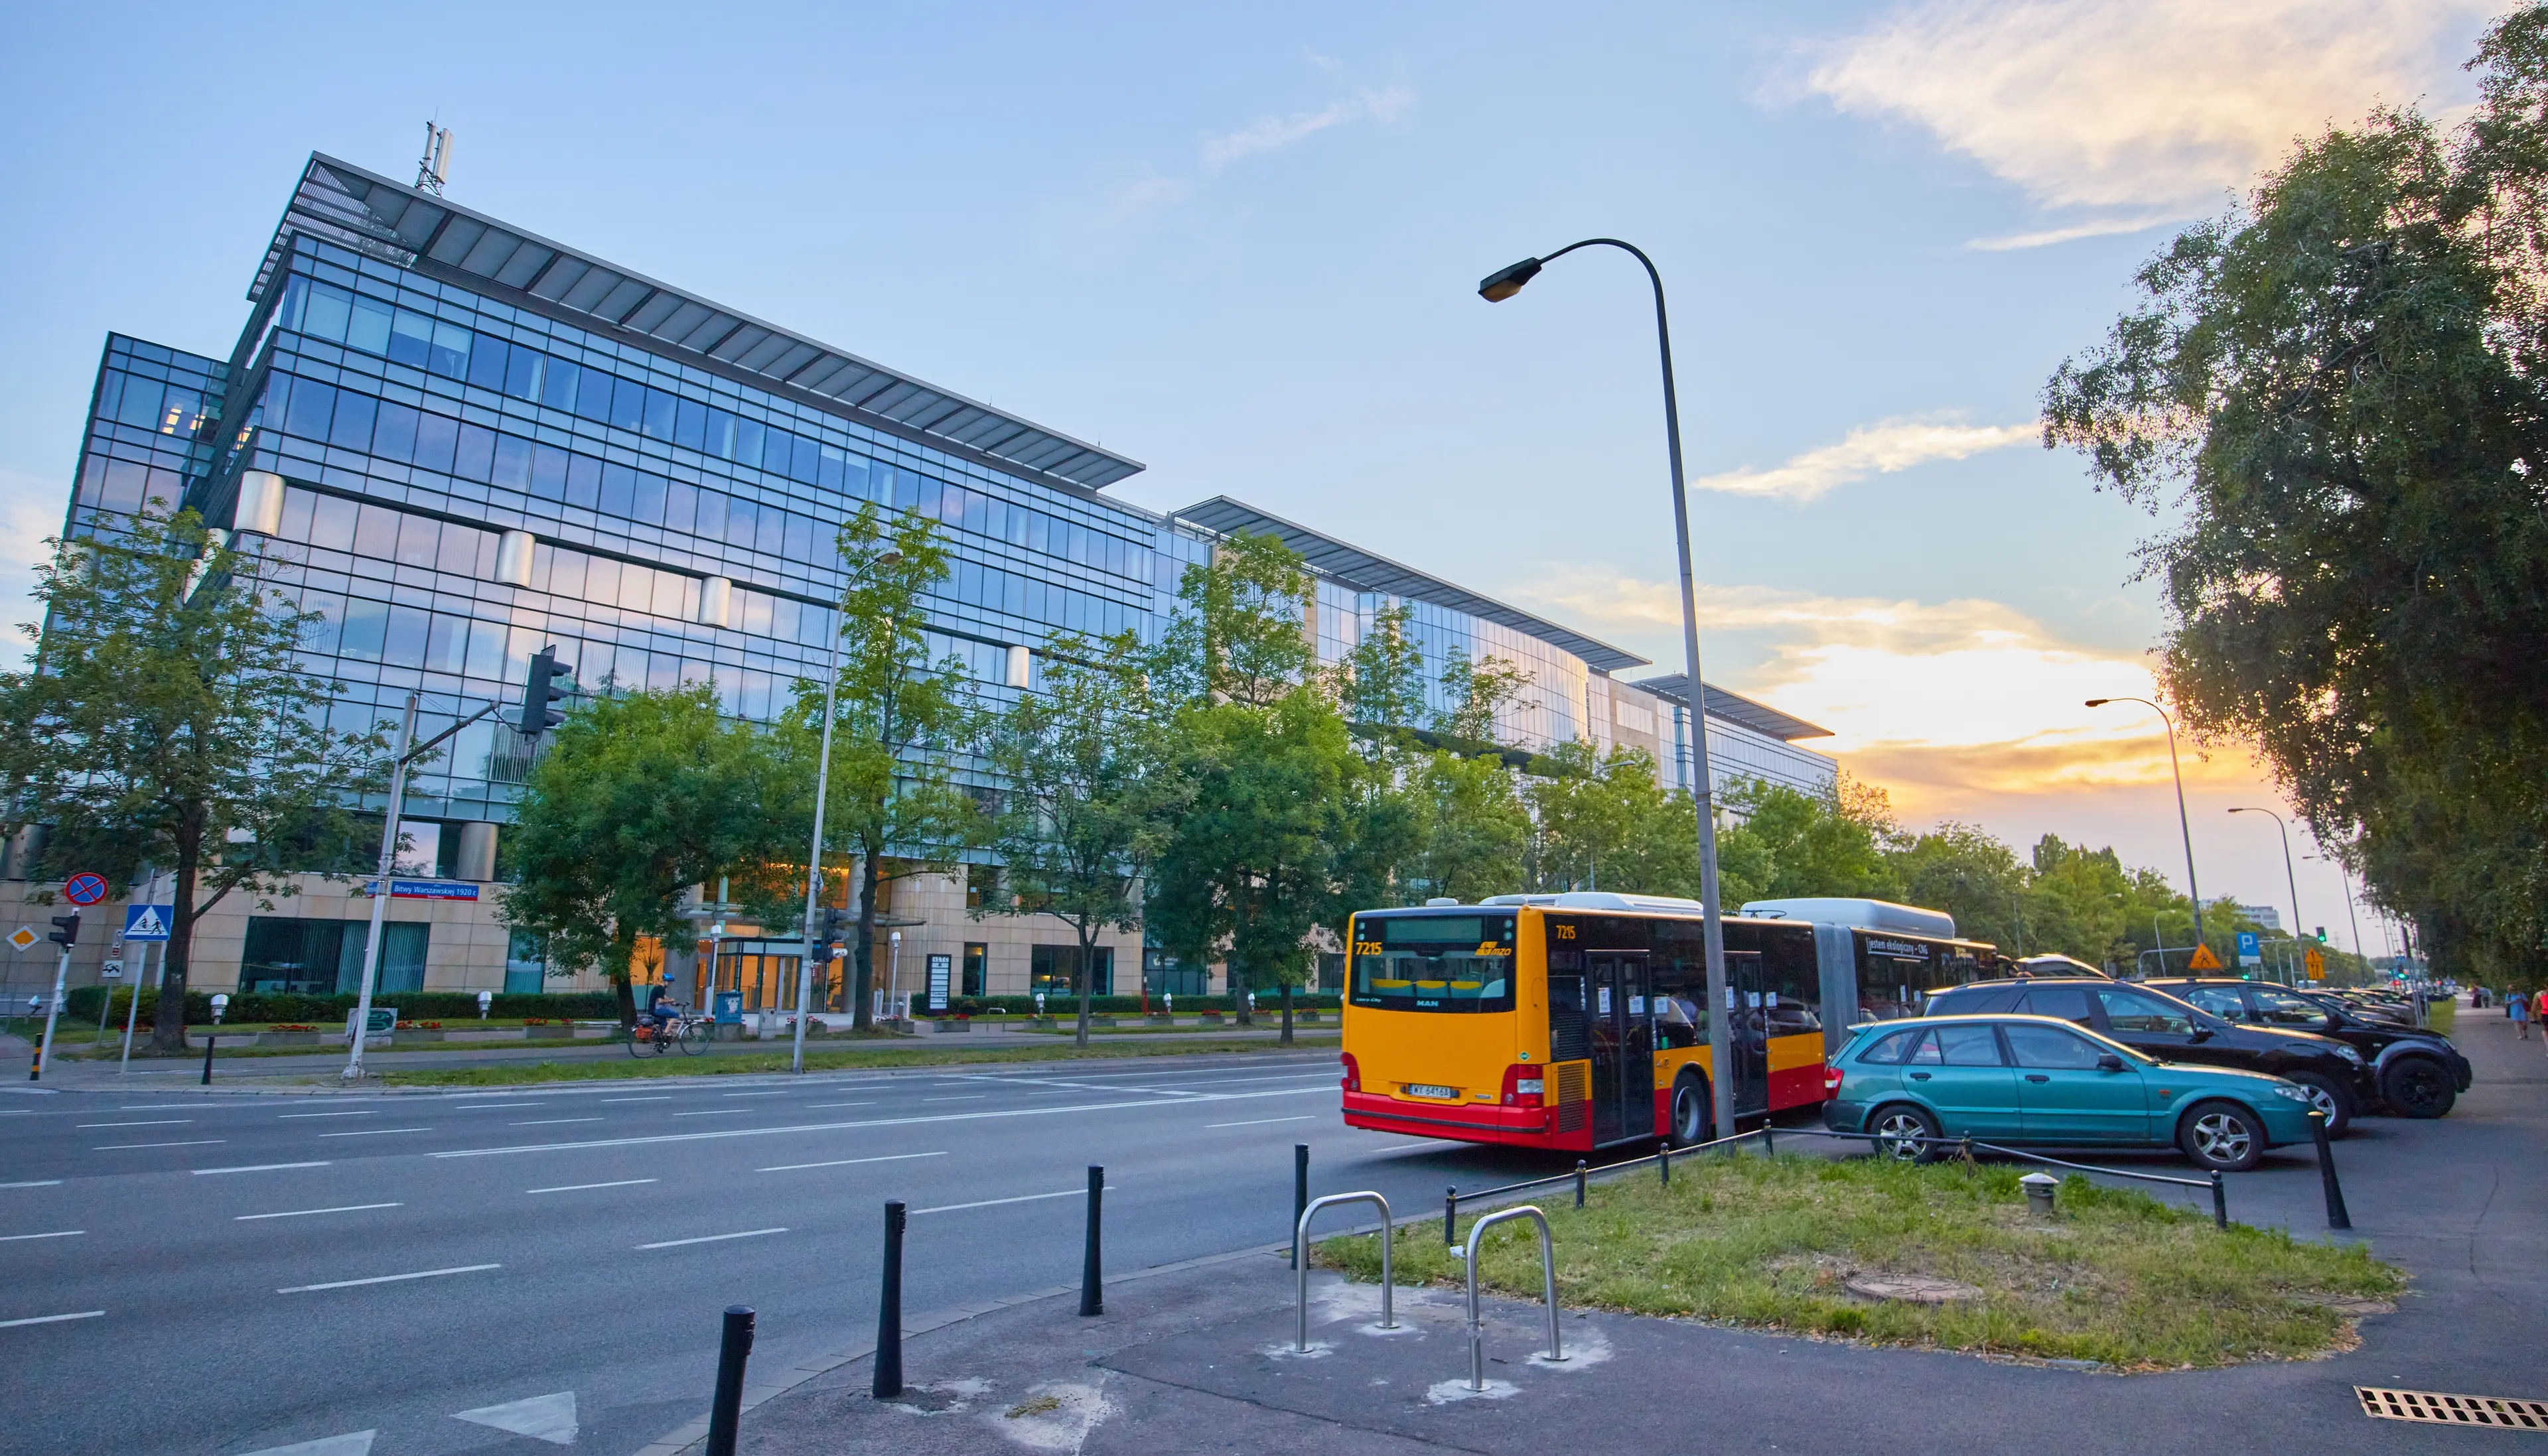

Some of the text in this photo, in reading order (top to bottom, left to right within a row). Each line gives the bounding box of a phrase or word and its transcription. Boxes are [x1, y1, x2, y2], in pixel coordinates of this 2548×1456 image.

[414, 886, 455, 895] Warszawskiej
[1555, 925, 1576, 939] 7215
[1356, 942, 1382, 955] 7215
[1868, 937, 1885, 951] jestem
[1886, 939, 1914, 955] ekologiczny
[2241, 935, 2253, 949] P
